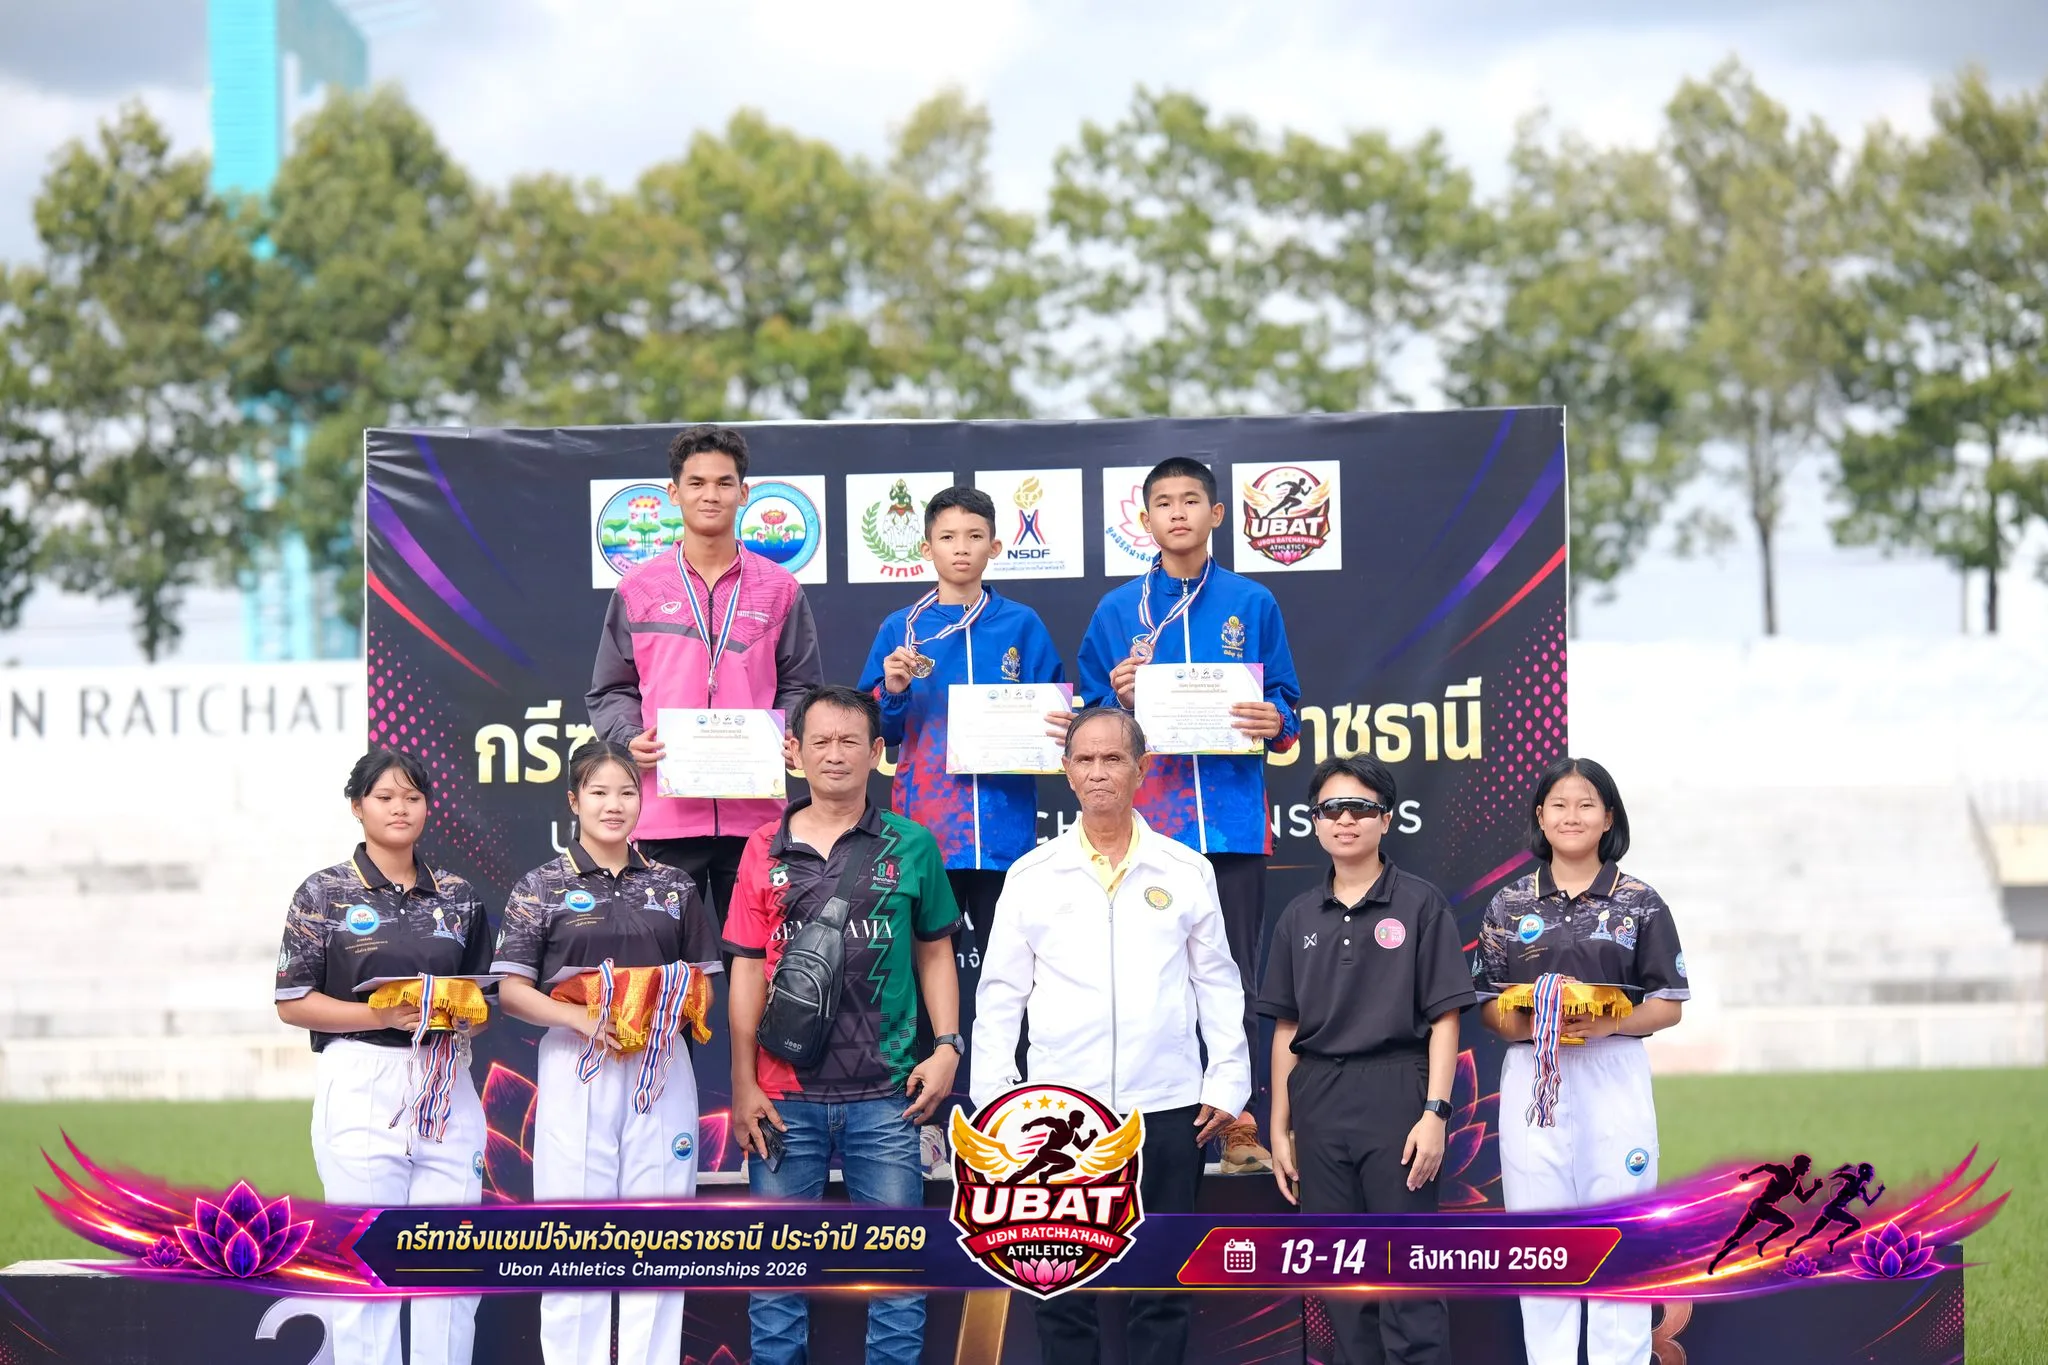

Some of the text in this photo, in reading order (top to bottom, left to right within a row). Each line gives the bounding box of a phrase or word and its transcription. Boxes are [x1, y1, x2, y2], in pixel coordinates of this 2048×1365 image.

[1250, 517, 1325, 538] UBAT
[1007, 549, 1050, 560] NSDF
[877, 862, 895, 879] 84
[784, 1038, 802, 1050] Jeep
